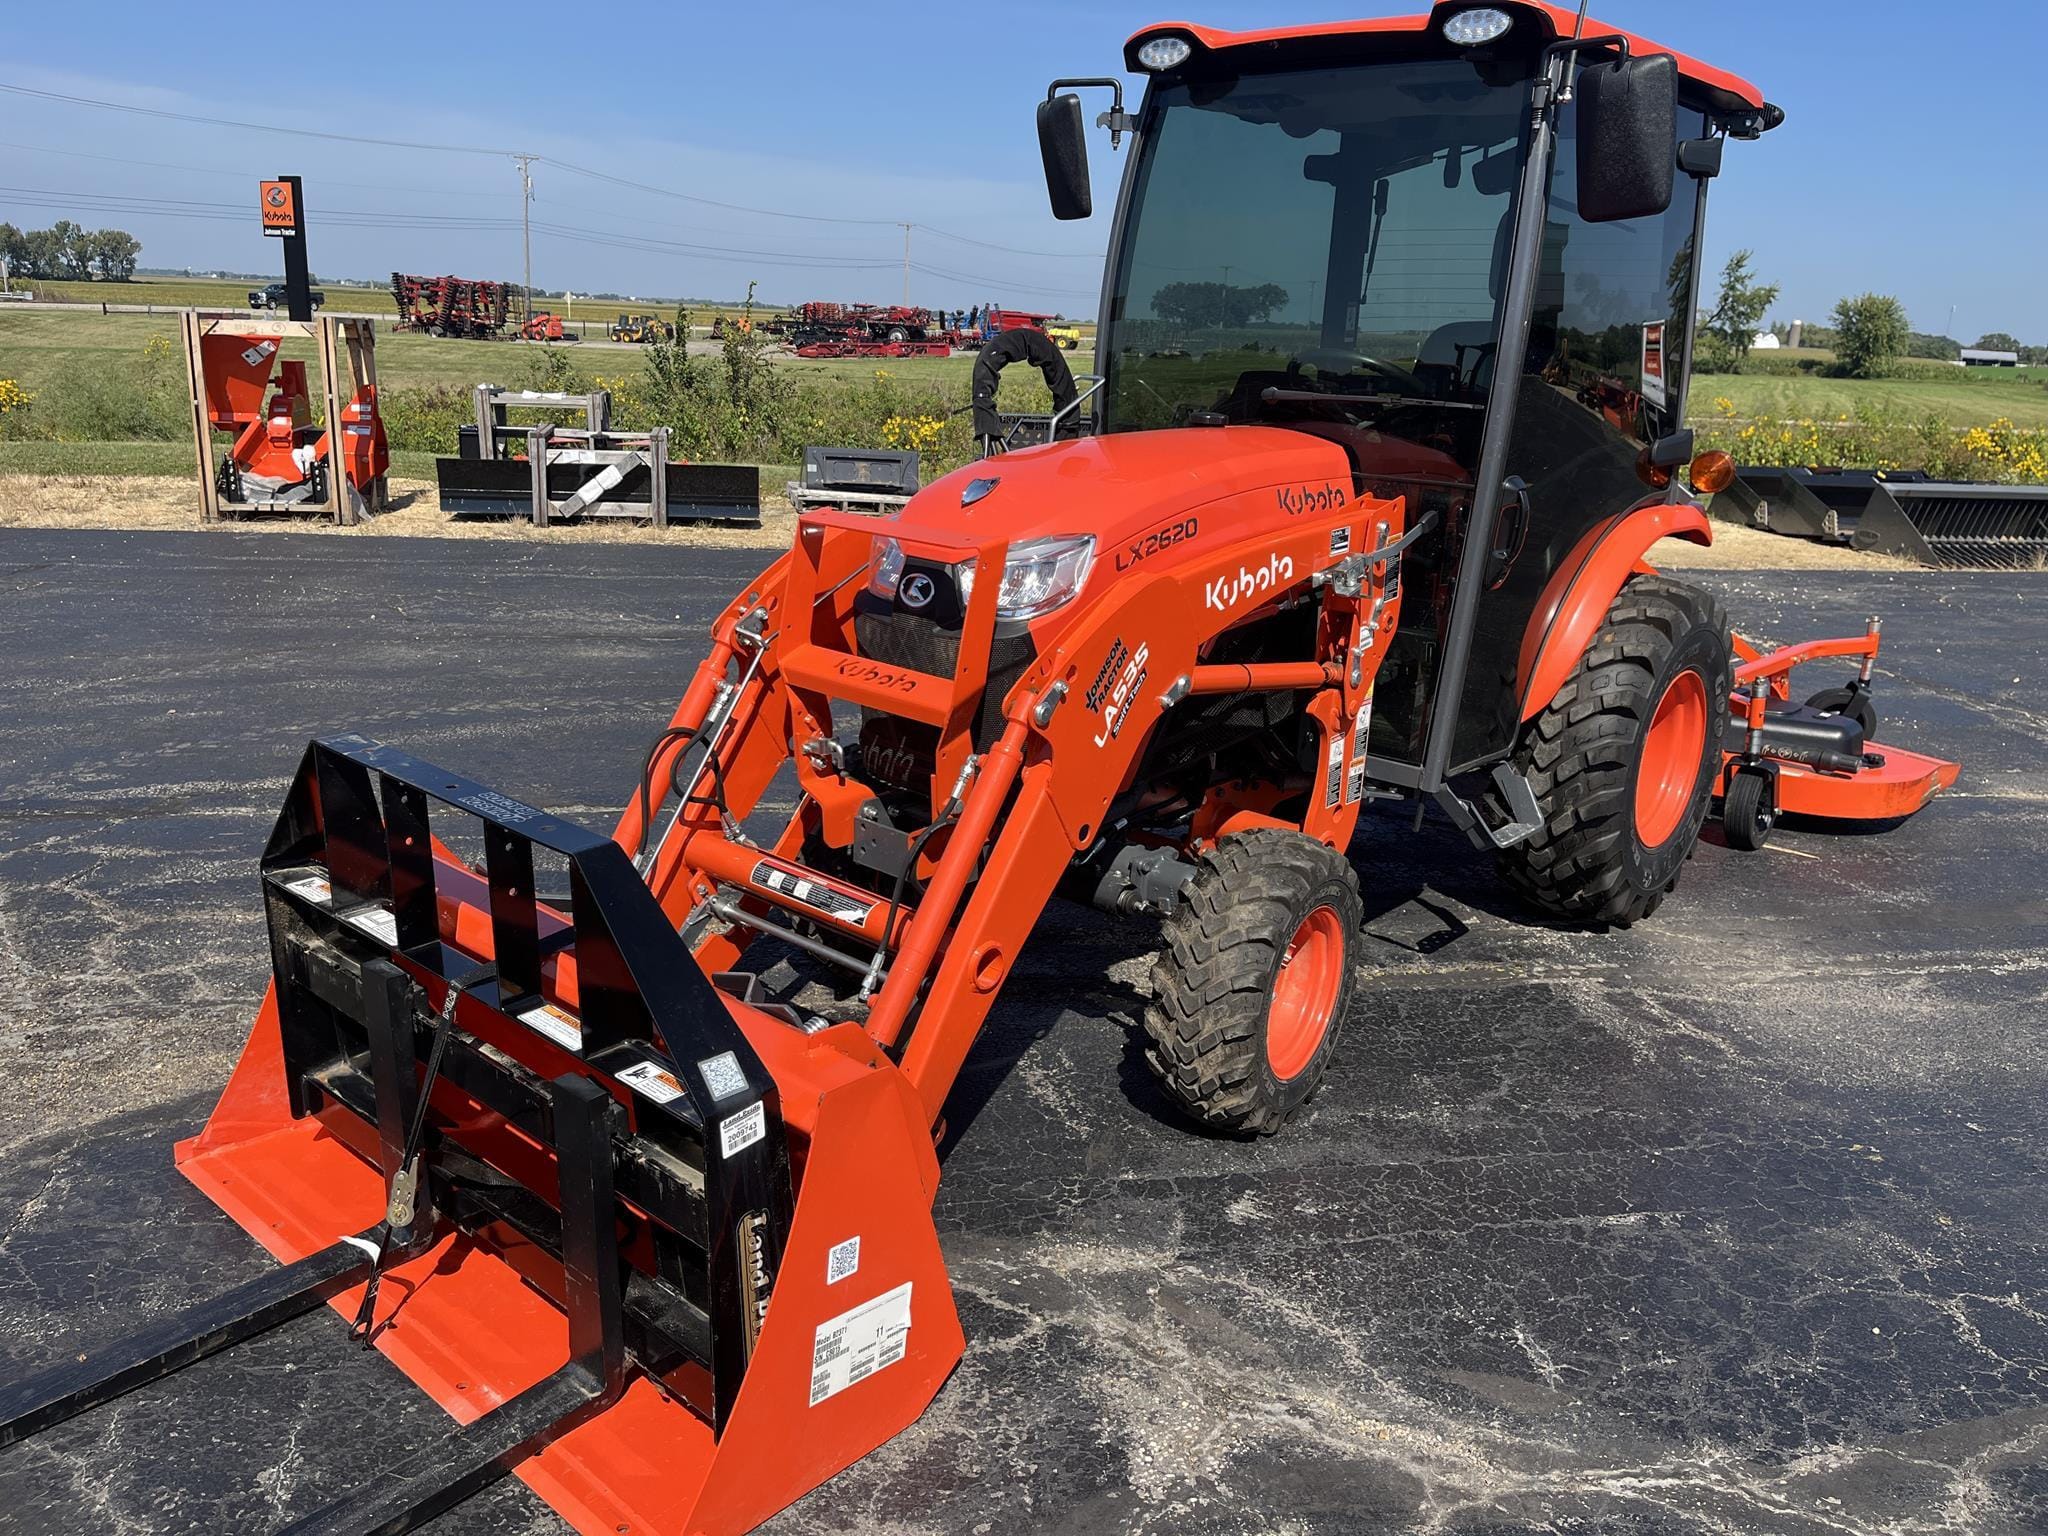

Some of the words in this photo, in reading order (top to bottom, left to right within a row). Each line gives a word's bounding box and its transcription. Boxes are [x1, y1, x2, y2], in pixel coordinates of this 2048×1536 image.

[264, 210, 293, 222] Kubota
[1277, 482, 1345, 515] Kubota
[1115, 517, 1198, 572] LX2620
[1205, 552, 1293, 611] Kubota
[833, 658, 917, 692] Kubota
[1094, 641, 1149, 748] LA535
[727, 1121, 757, 1143] 2009743
[746, 1211, 770, 1292] Land
